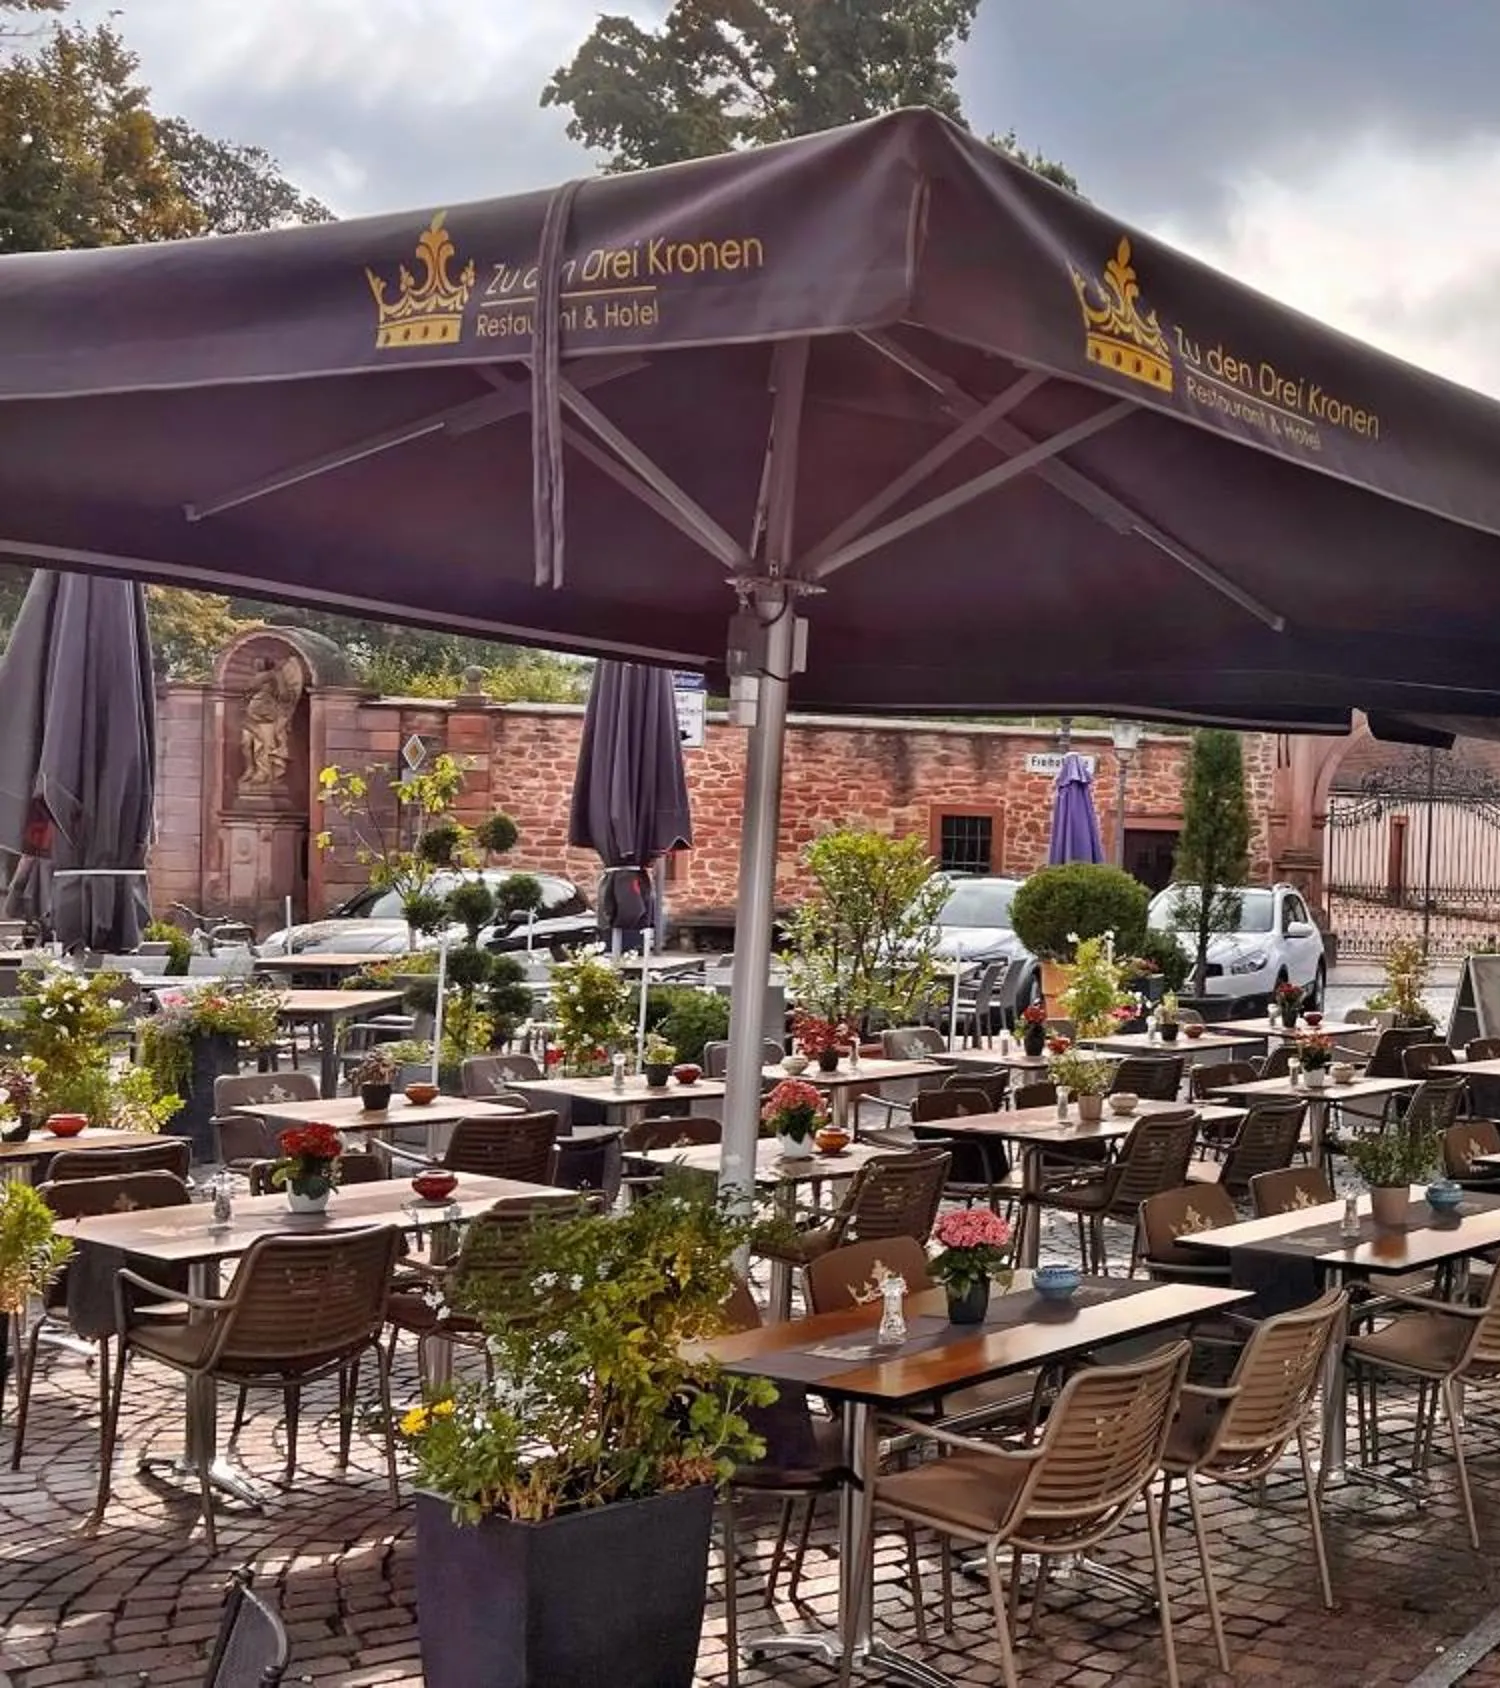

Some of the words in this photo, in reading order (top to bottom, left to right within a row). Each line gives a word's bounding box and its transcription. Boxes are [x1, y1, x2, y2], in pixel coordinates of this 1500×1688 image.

[485, 263, 518, 296] Zu
[582, 241, 640, 282] Drei
[649, 236, 764, 277] Kronen
[584, 305, 597, 329] &
[604, 299, 659, 328] Hotel
[1174, 324, 1202, 366] Zu
[1207, 345, 1253, 389] den
[1259, 363, 1304, 414] Drei
[1308, 384, 1381, 440] Kronen
[1186, 375, 1267, 430] Restaurant
[1285, 421, 1321, 451] Hotel
